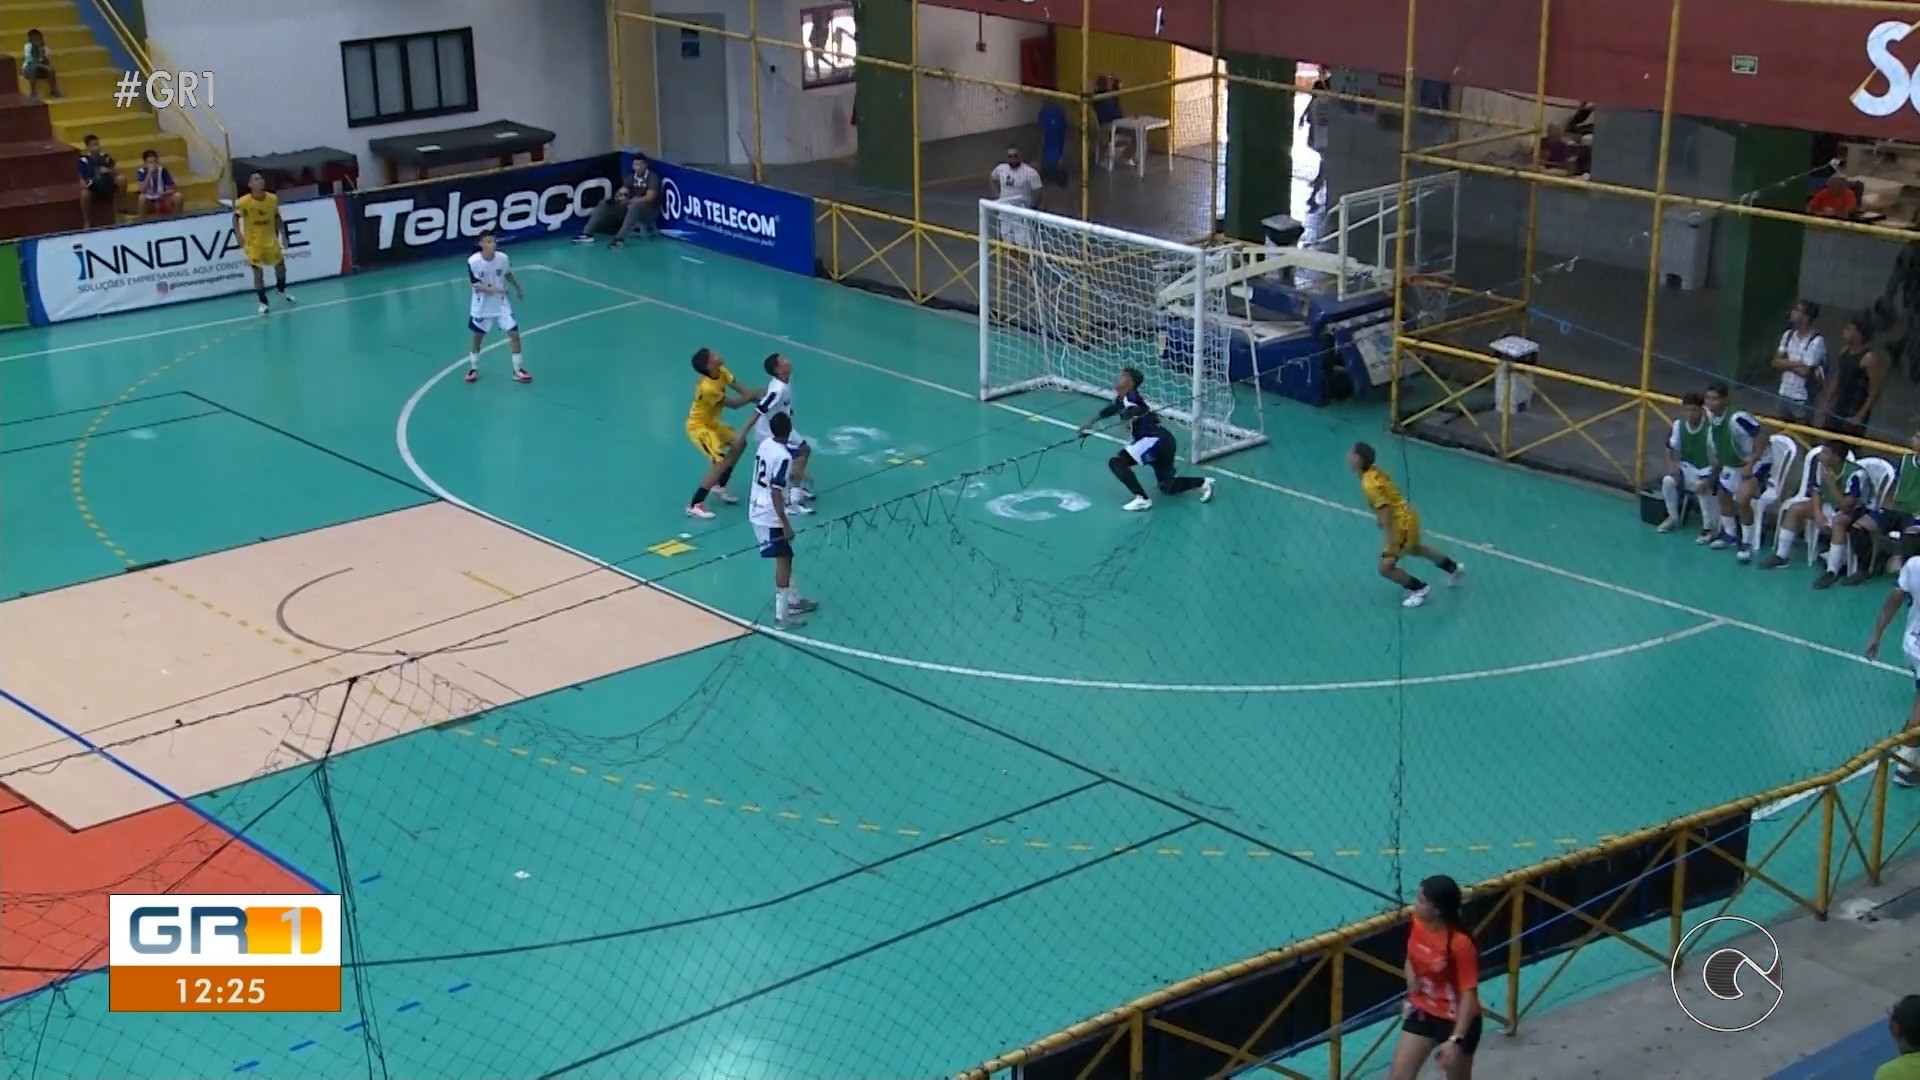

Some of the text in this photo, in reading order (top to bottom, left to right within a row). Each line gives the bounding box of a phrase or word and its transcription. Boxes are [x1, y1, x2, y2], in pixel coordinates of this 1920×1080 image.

[1849, 20, 1920, 117] S
[364, 177, 612, 250] Teleaço
[683, 195, 703, 218] JR
[704, 199, 777, 238] TELECOM
[756, 455, 768, 488] 12
